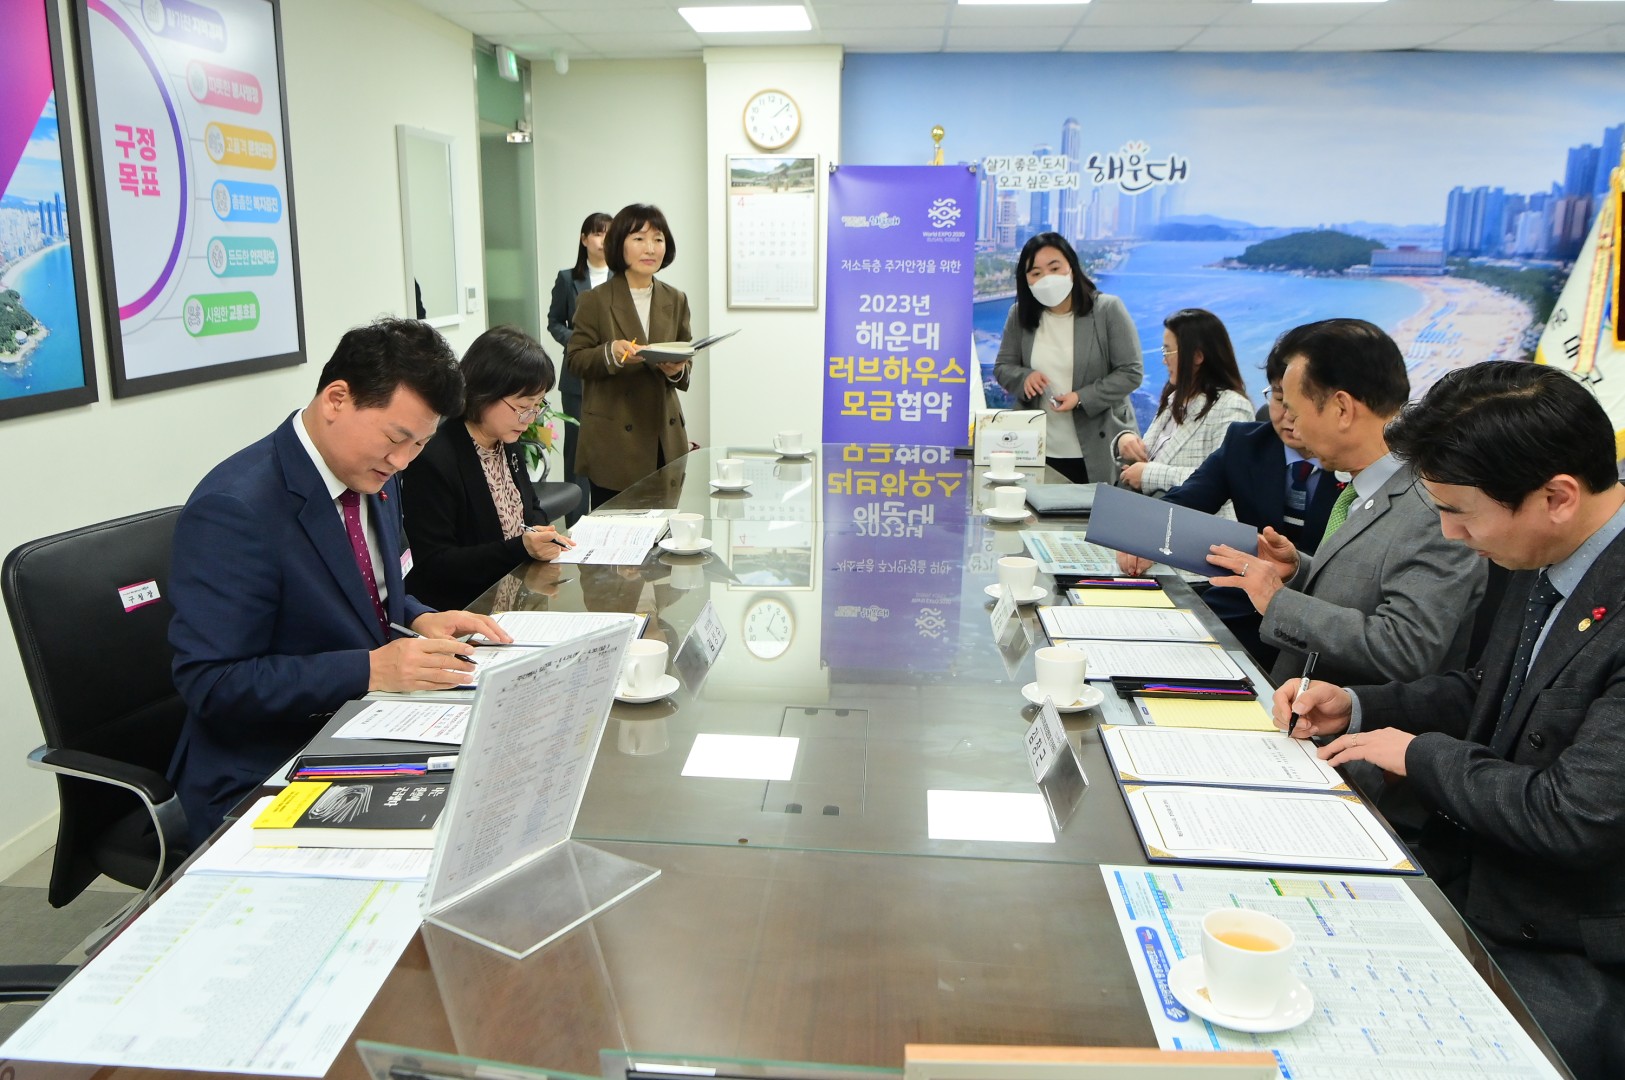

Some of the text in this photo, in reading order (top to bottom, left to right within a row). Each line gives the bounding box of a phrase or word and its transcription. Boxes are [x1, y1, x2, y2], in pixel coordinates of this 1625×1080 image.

[115, 123, 156, 162] 구정
[986, 157, 1066, 173] 살기 좋은 도시
[1086, 153, 1188, 192] 해운대
[119, 162, 161, 198] 목표
[999, 174, 1078, 189] 오고 싶은 도시
[228, 249, 249, 267] 든든한
[841, 260, 961, 273] 저소득층 주거안정을 위한
[206, 305, 228, 323] 시원한
[859, 294, 930, 316] 2023년
[856, 320, 940, 352] 해운대
[829, 356, 966, 386] 러브하우스
[840, 390, 952, 423] 모금협약
